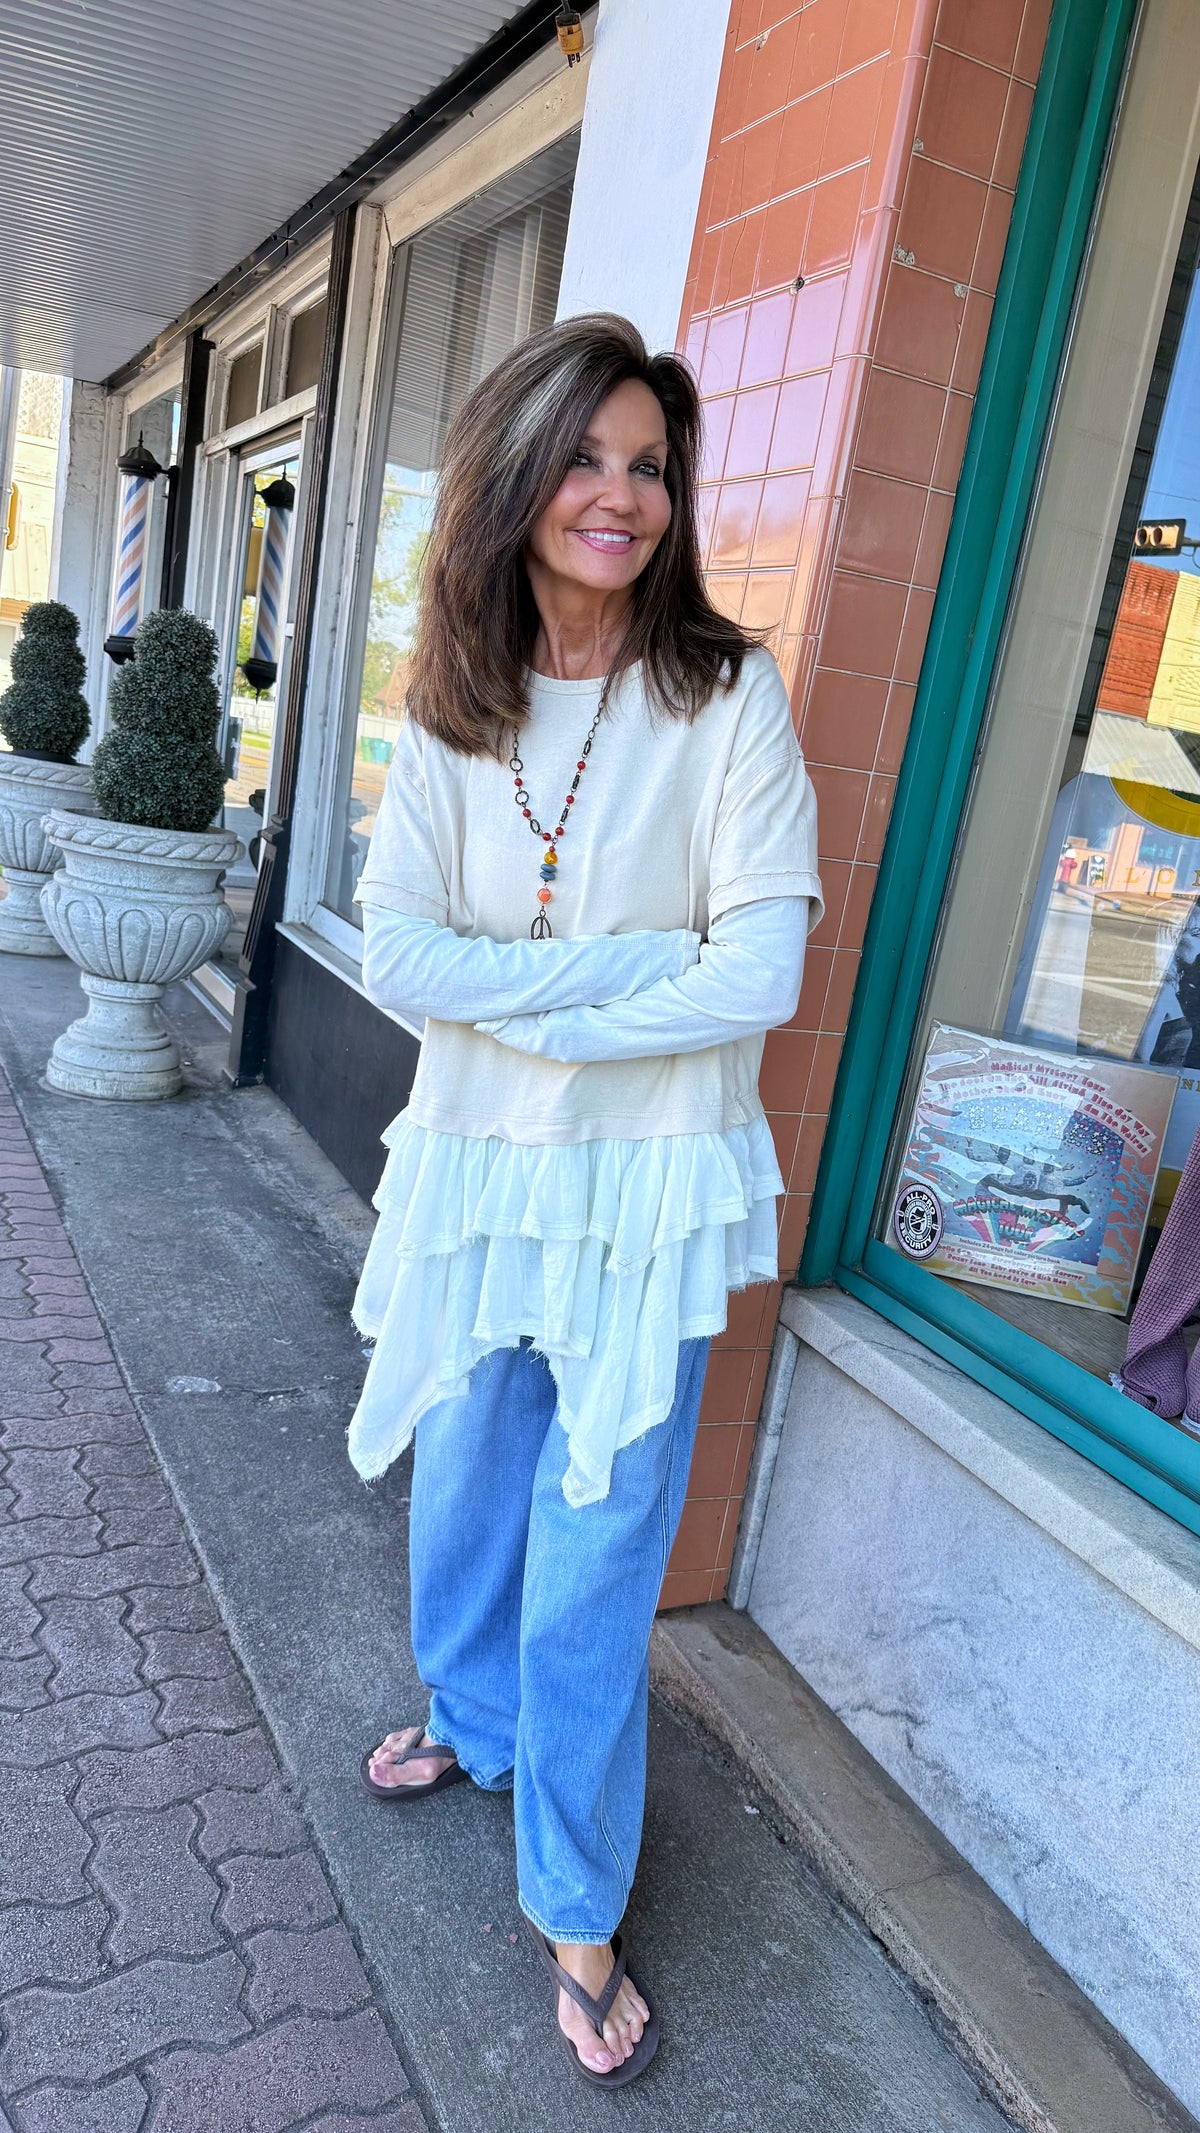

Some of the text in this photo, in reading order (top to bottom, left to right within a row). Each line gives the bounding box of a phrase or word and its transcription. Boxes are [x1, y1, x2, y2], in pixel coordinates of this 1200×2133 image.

[991, 1062, 1105, 1092] Magical Mystery Tour
[1091, 1093, 1113, 1111] Blue
[1133, 1120, 1150, 1138] Way
[1100, 1112, 1118, 1128] The
[1120, 1124, 1148, 1154] Walrus
[906, 1191, 935, 1215] ALL-PRO
[900, 1222, 933, 1250] SECURITY
[959, 1237, 982, 1247] Includes
